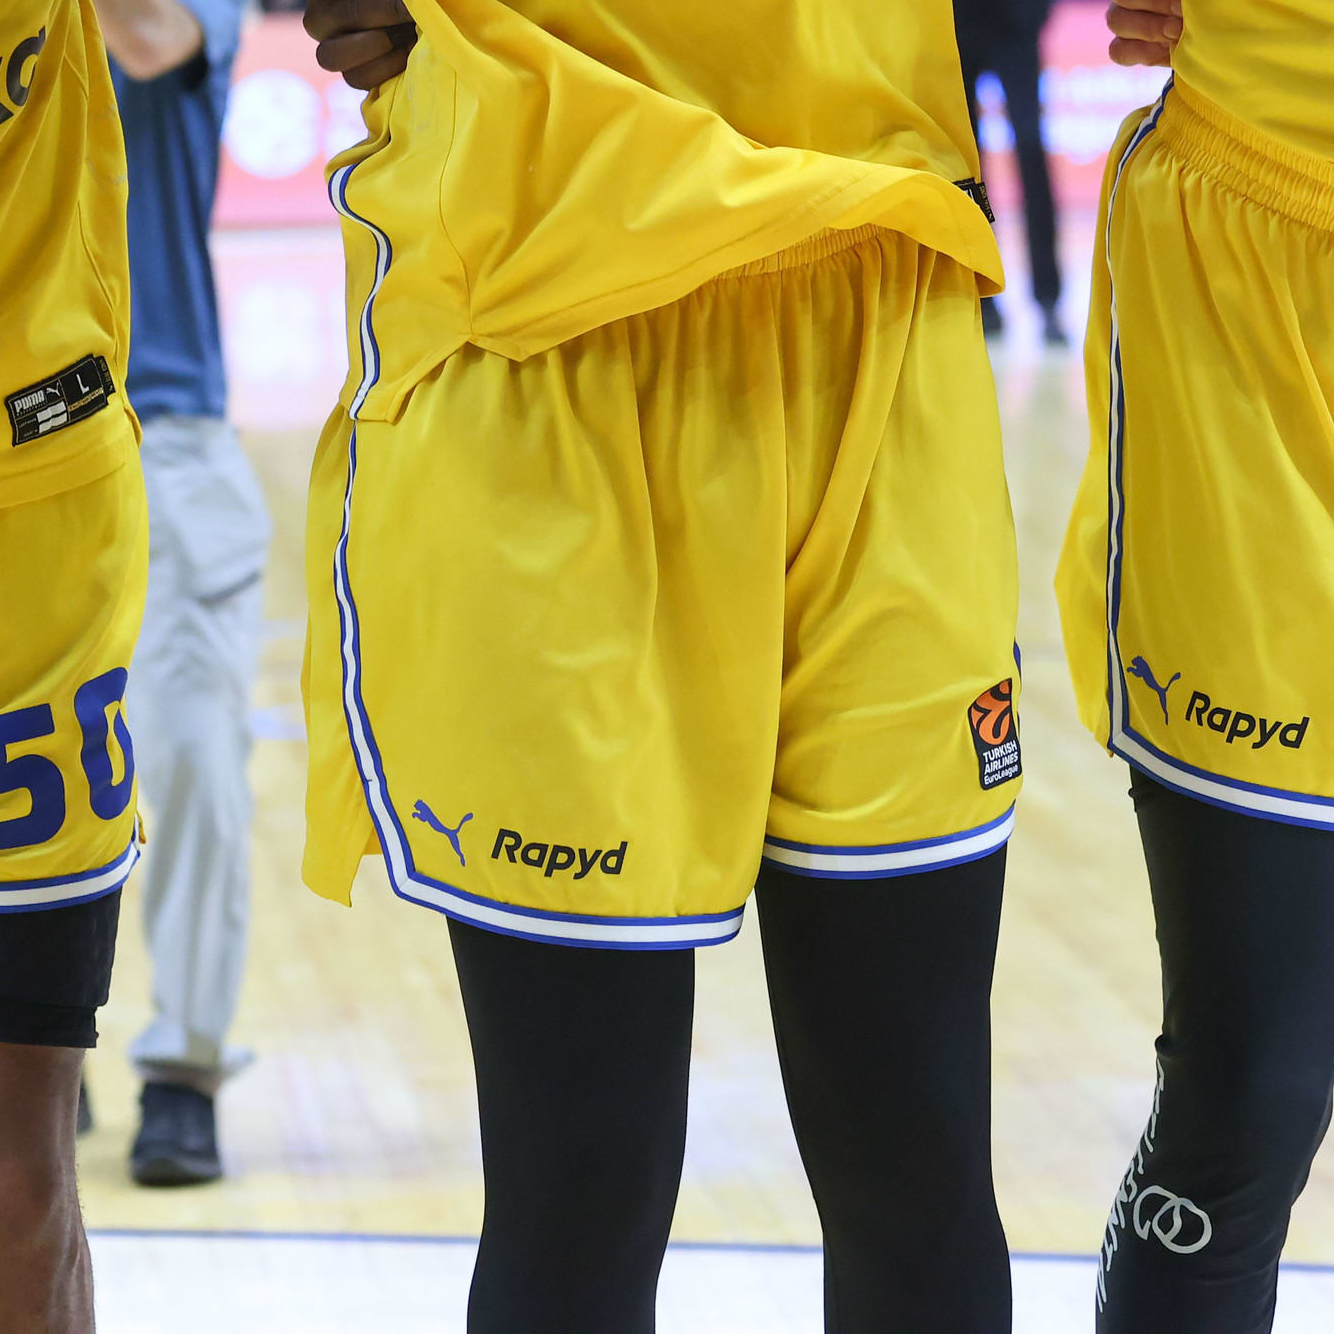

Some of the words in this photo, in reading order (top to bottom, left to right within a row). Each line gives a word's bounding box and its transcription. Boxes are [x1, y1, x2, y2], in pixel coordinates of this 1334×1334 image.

[76, 374, 89, 394] L
[13, 390, 45, 413] PUMA
[1186, 690, 1310, 749] Rapyd
[982, 740, 1017, 762] TURKISH
[984, 752, 1018, 775] AIRLINES
[984, 765, 1018, 785] EuroLeague
[490, 828, 628, 880] Rapyd
